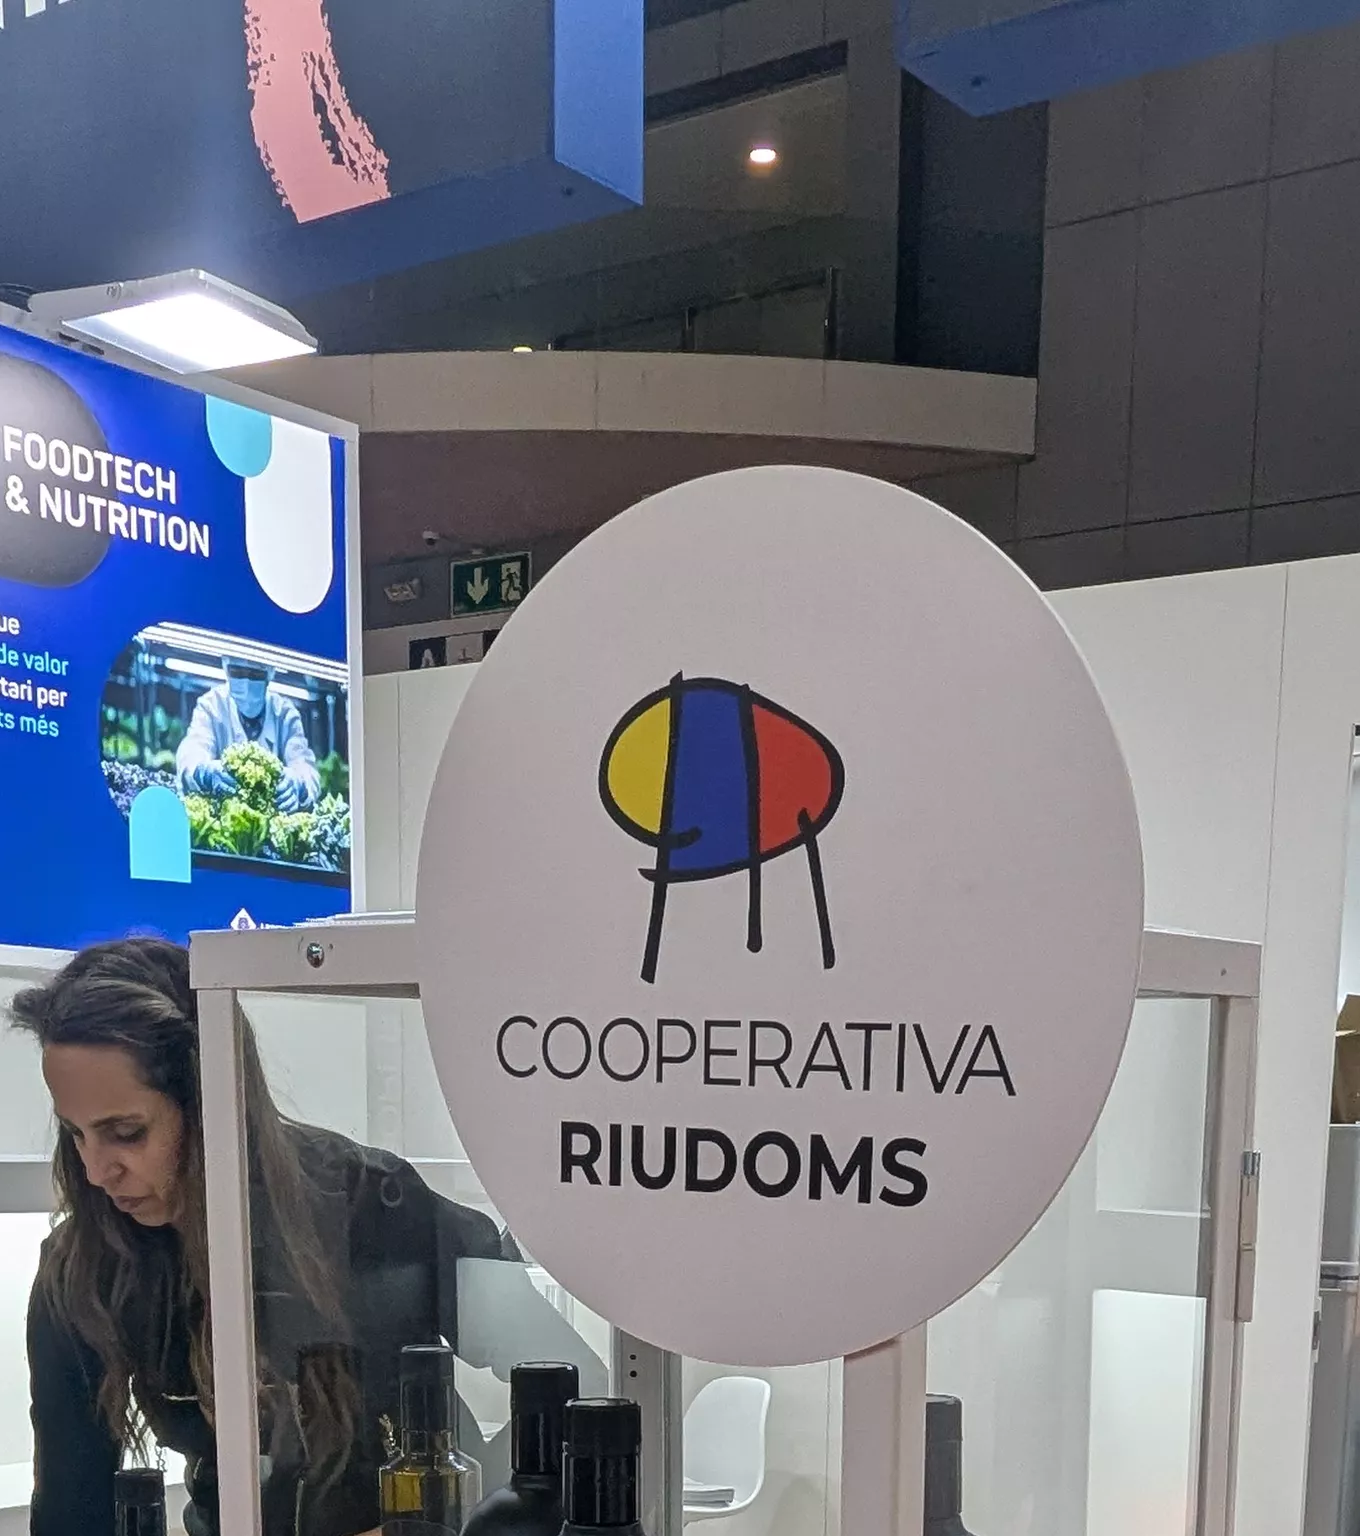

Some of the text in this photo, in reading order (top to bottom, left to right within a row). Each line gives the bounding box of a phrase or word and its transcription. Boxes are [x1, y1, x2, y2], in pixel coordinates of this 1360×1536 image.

[2, 425, 177, 505] FOODTECH
[4, 474, 210, 558] & NUTRITION
[23, 651, 69, 677] valor
[36, 686, 68, 708] per
[19, 713, 60, 738] més
[495, 1015, 1017, 1097] COOPERATIVA
[558, 1120, 929, 1208] RIUDOMS
